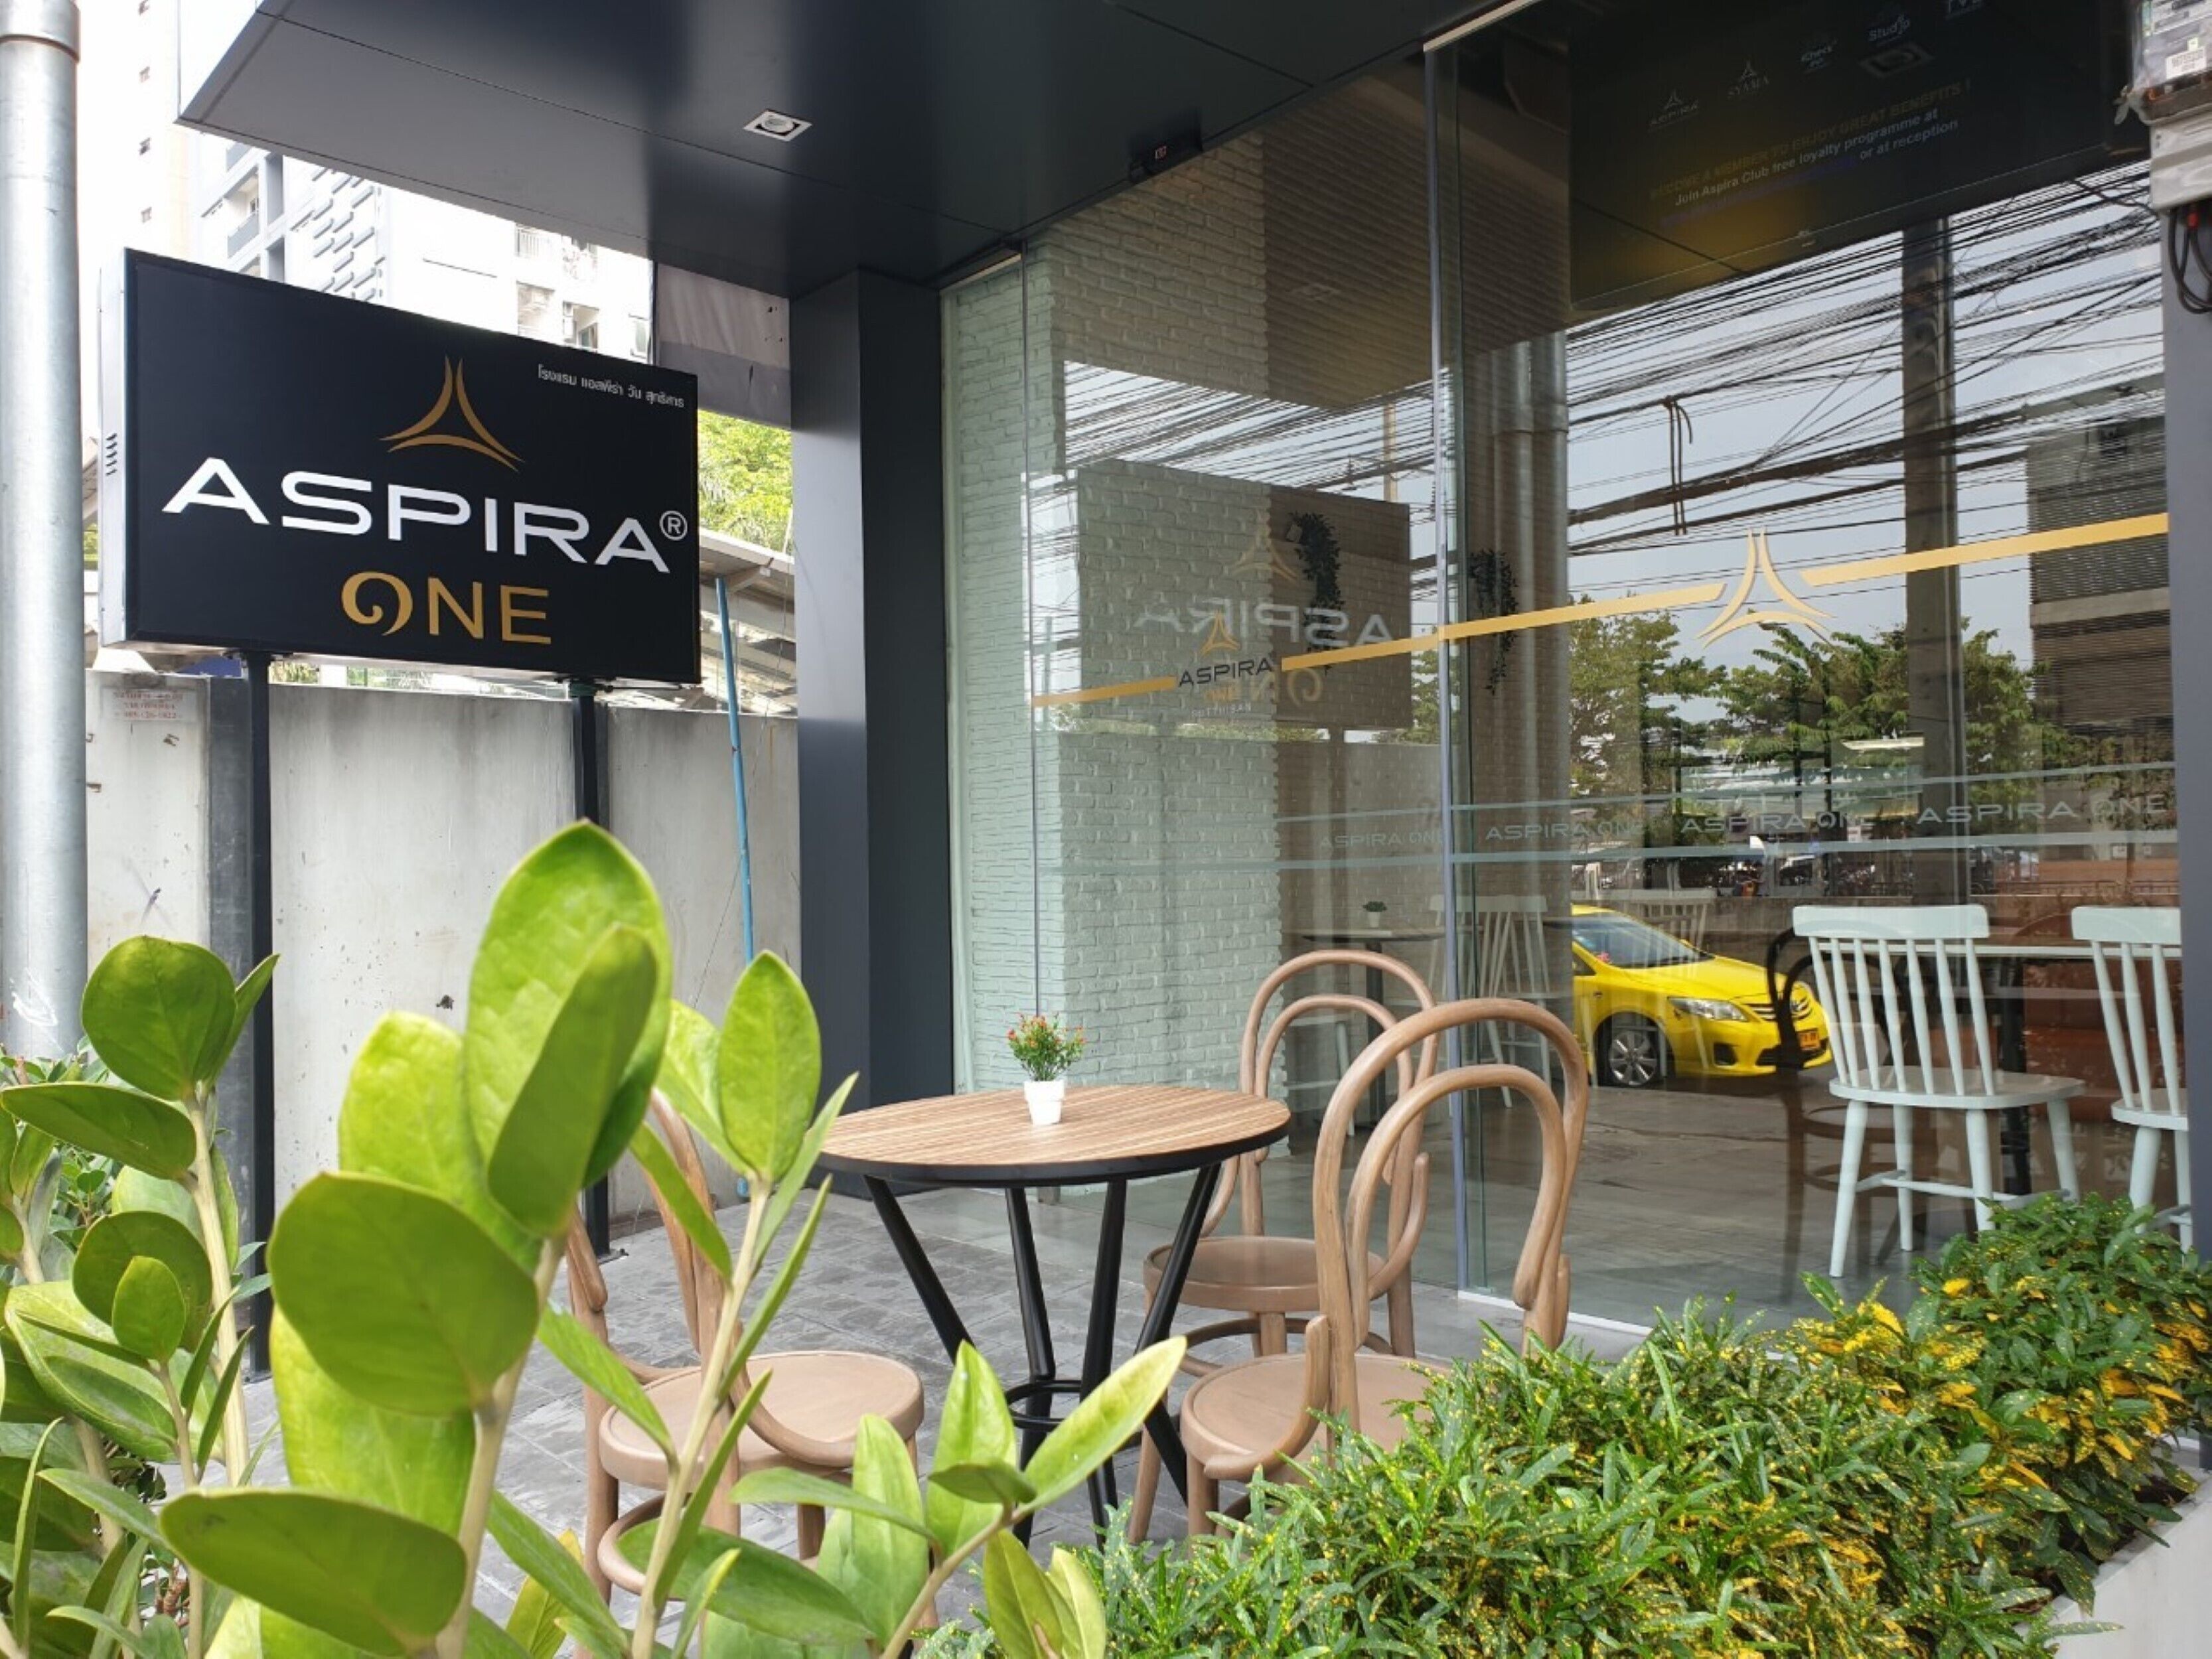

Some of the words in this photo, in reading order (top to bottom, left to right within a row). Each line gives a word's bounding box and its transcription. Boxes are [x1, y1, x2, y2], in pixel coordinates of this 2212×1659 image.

[1860, 148, 1874, 161] or
[1877, 140, 1889, 155] at
[1893, 118, 1958, 149] reception
[1675, 188, 1700, 206] Join
[1701, 177, 1739, 197] Aspira
[1742, 165, 1769, 184] Club
[1772, 157, 1796, 173] free
[1799, 140, 1840, 165] loyalty
[1844, 114, 1920, 149] programme
[1923, 107, 1938, 122] at
[538, 364, 577, 386] โรงแรม
[628, 384, 642, 399] วัน
[341, 571, 552, 645] ONE
[1179, 658, 1273, 687] ASPIRA
[1680, 814, 1806, 833] ASPIRA
[1917, 801, 2079, 824] ASPIRA
[2091, 794, 2170, 818] ONE
[1319, 832, 1402, 850] ASPIRA
[1485, 822, 1589, 840] ASPIRA
